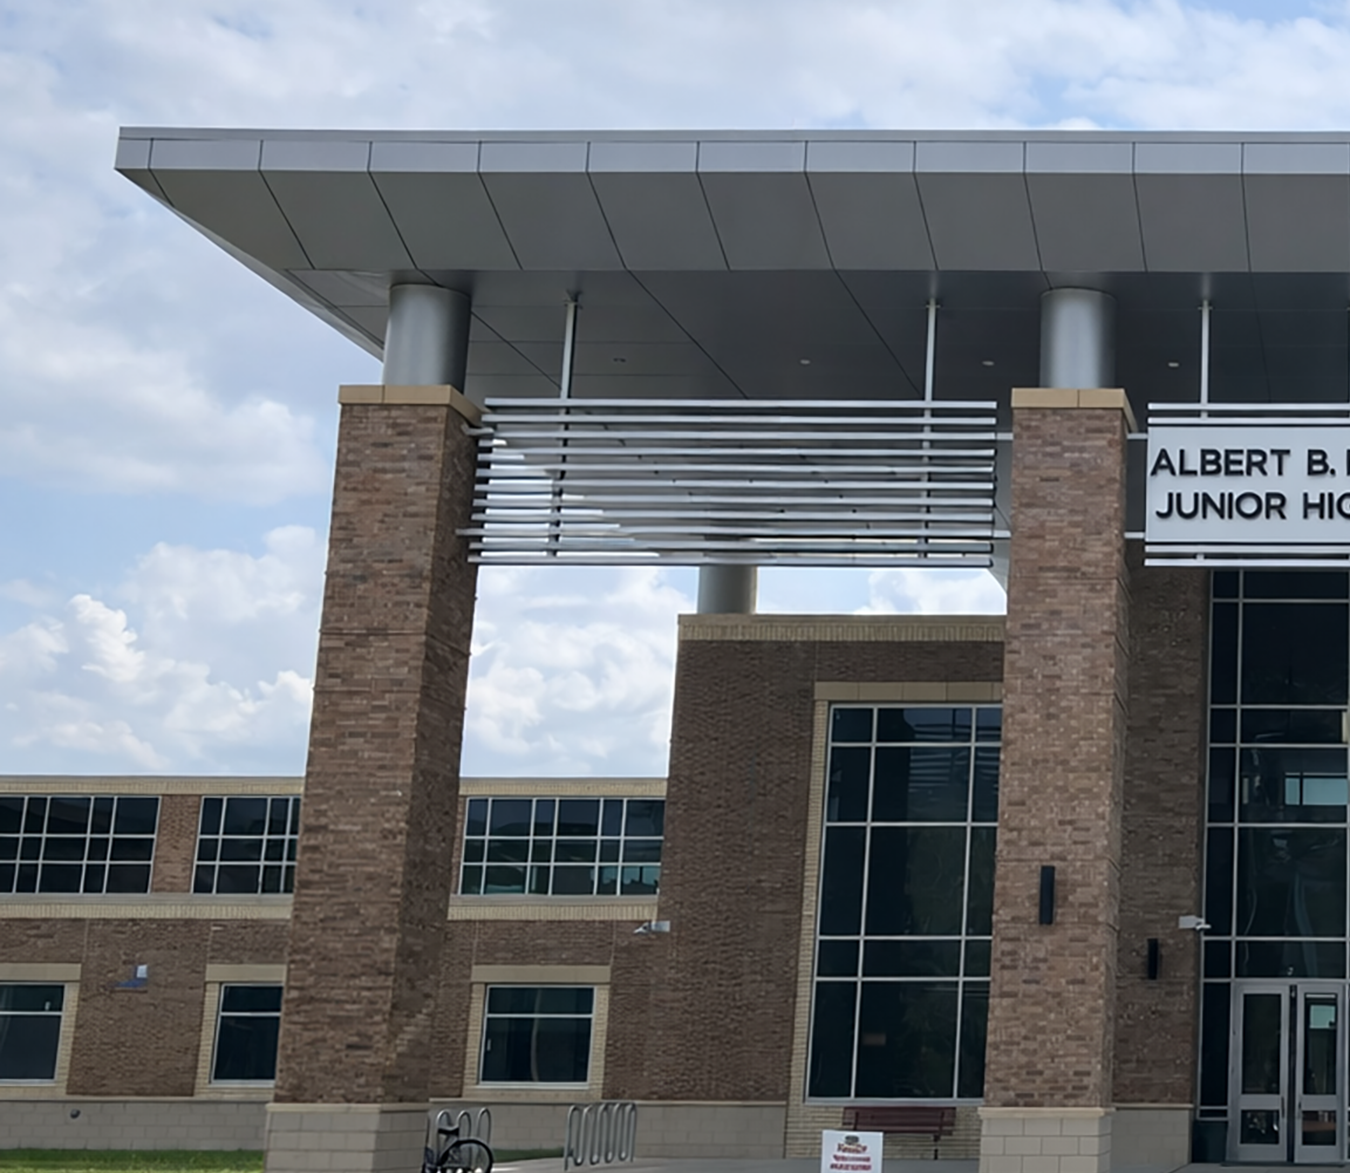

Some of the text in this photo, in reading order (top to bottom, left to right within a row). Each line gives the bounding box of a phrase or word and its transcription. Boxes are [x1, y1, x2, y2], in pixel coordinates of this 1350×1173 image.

[1150, 448, 1291, 477] ALBERT
[1307, 448, 1336, 477] B.
[1155, 491, 1287, 520] JUNIOR
